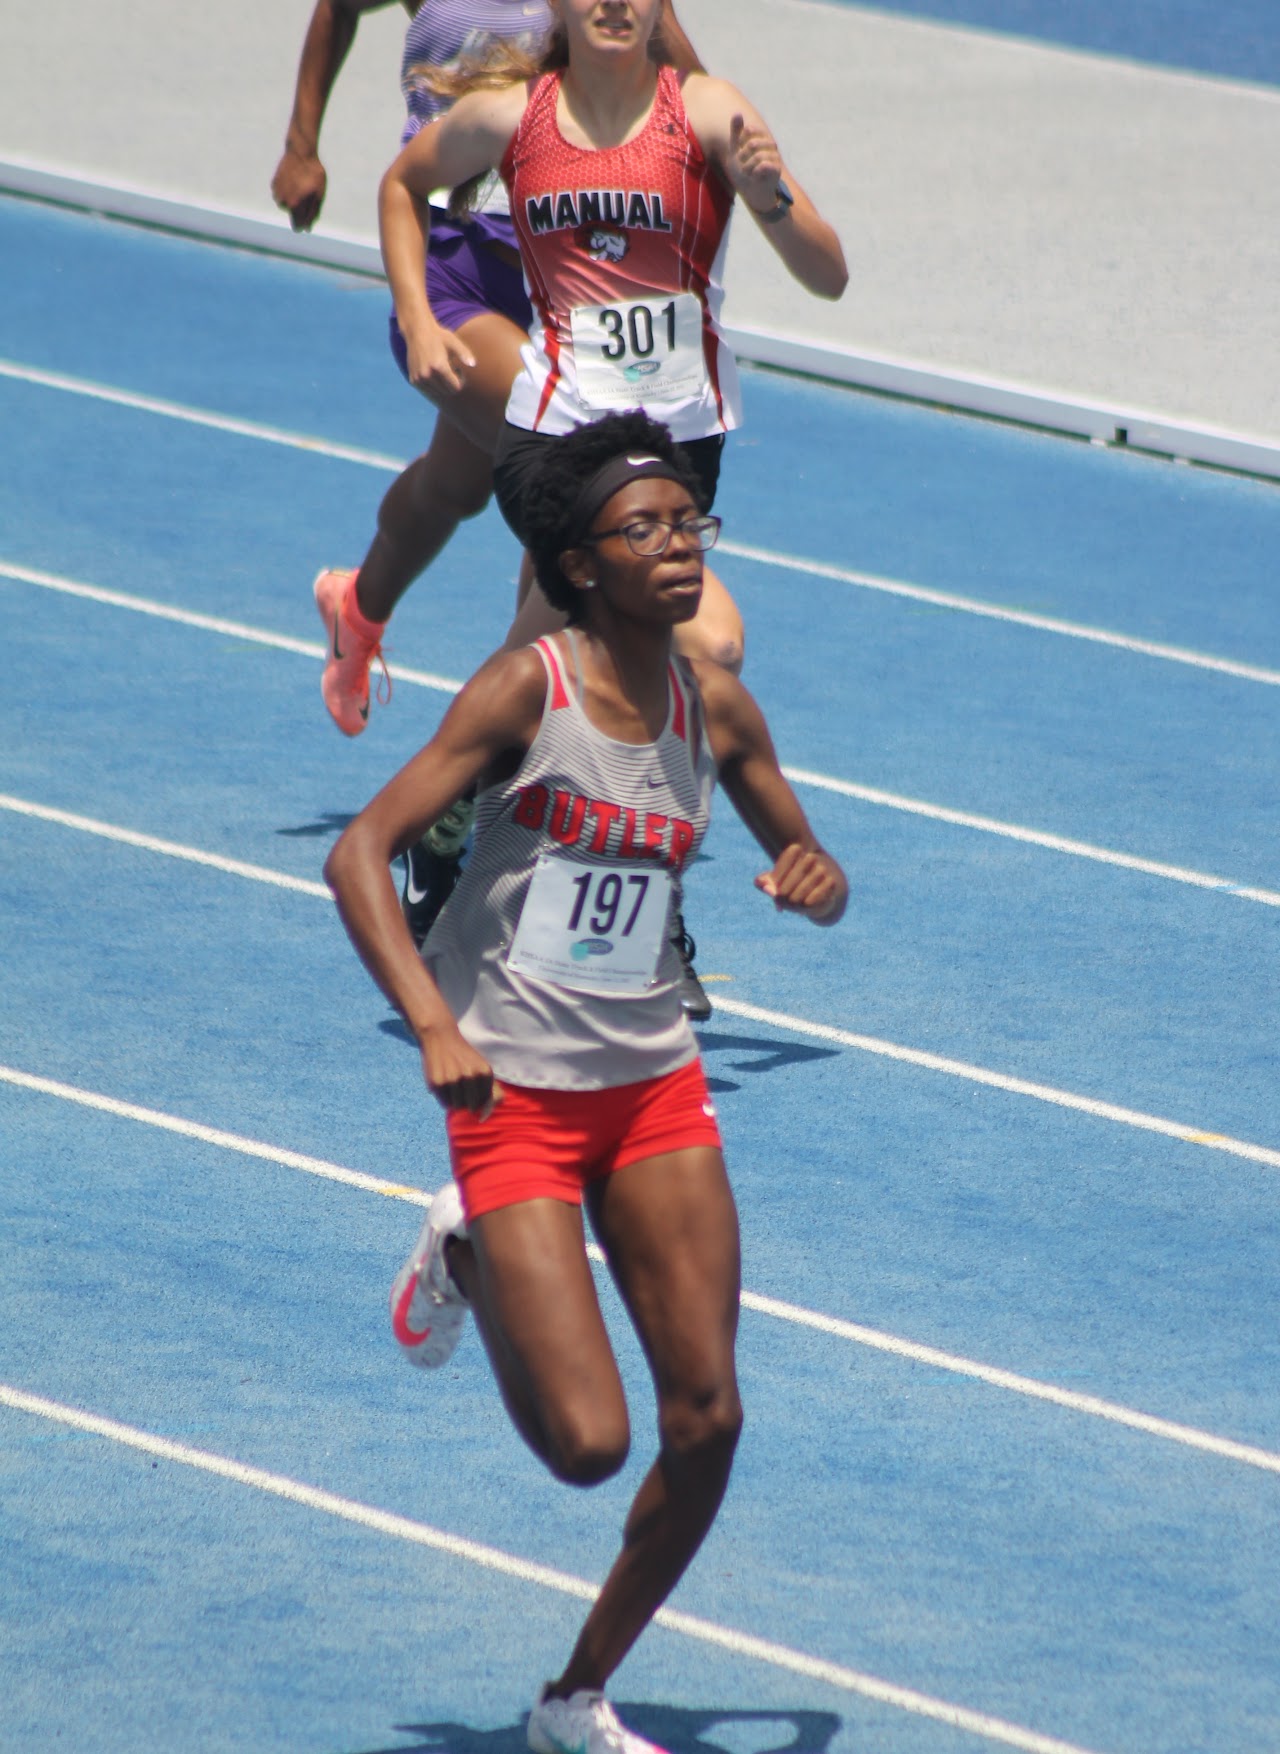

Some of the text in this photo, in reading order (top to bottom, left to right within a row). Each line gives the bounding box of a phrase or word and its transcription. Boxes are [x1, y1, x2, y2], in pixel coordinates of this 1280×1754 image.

[526, 191, 672, 235] MANUAL
[599, 301, 676, 362] 301
[514, 784, 695, 871] BUTLER
[568, 872, 650, 938] 197
